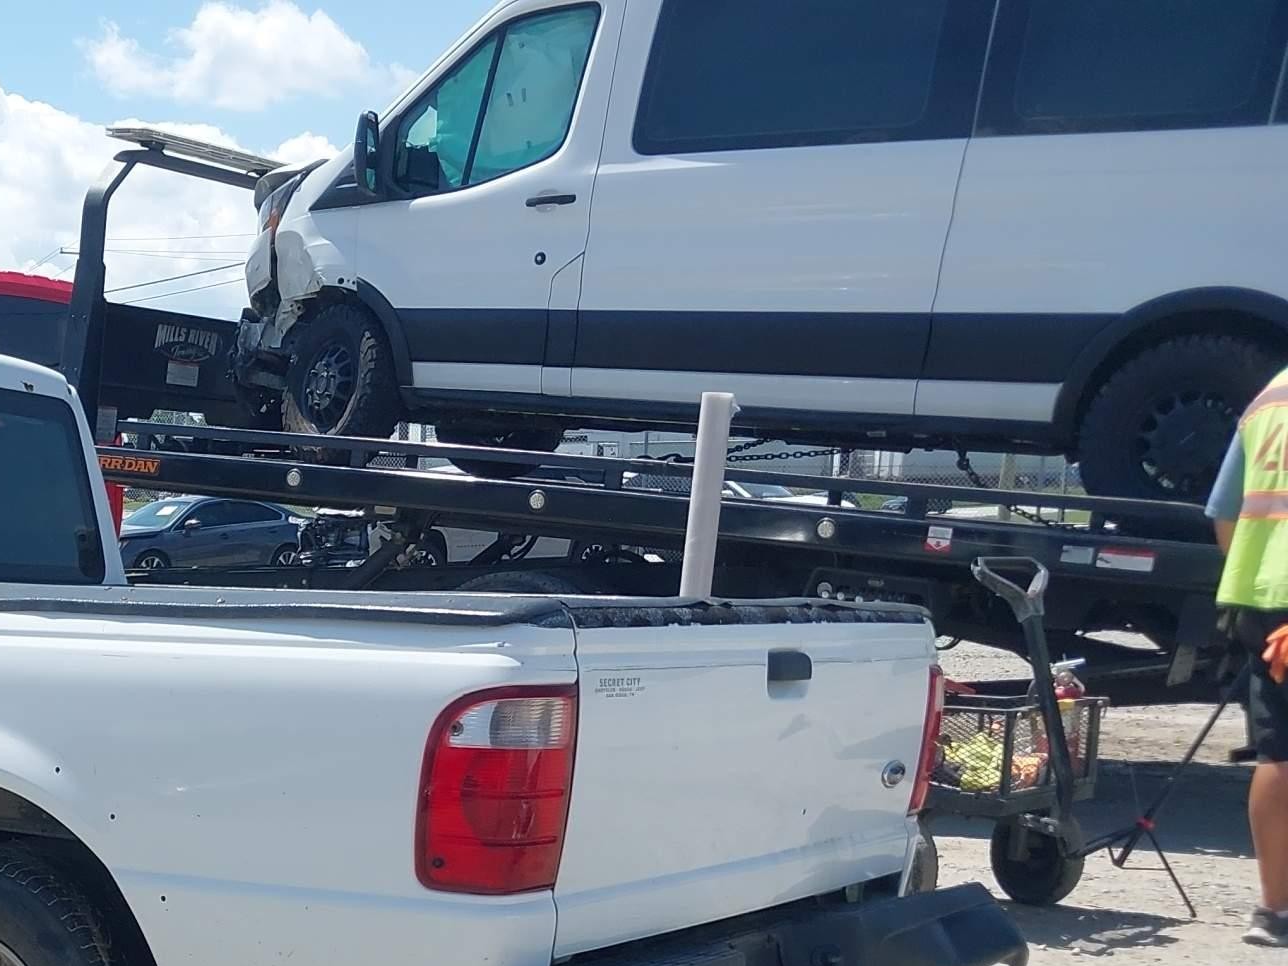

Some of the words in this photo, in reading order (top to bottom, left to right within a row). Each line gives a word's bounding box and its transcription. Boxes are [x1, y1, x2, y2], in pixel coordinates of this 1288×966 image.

[154, 324, 187, 349] MILLS
[188, 328, 218, 355] RIVER
[100, 456, 158, 473] RR-DAN
[599, 678, 625, 687] SECRET
[626, 677, 641, 687] CITY
